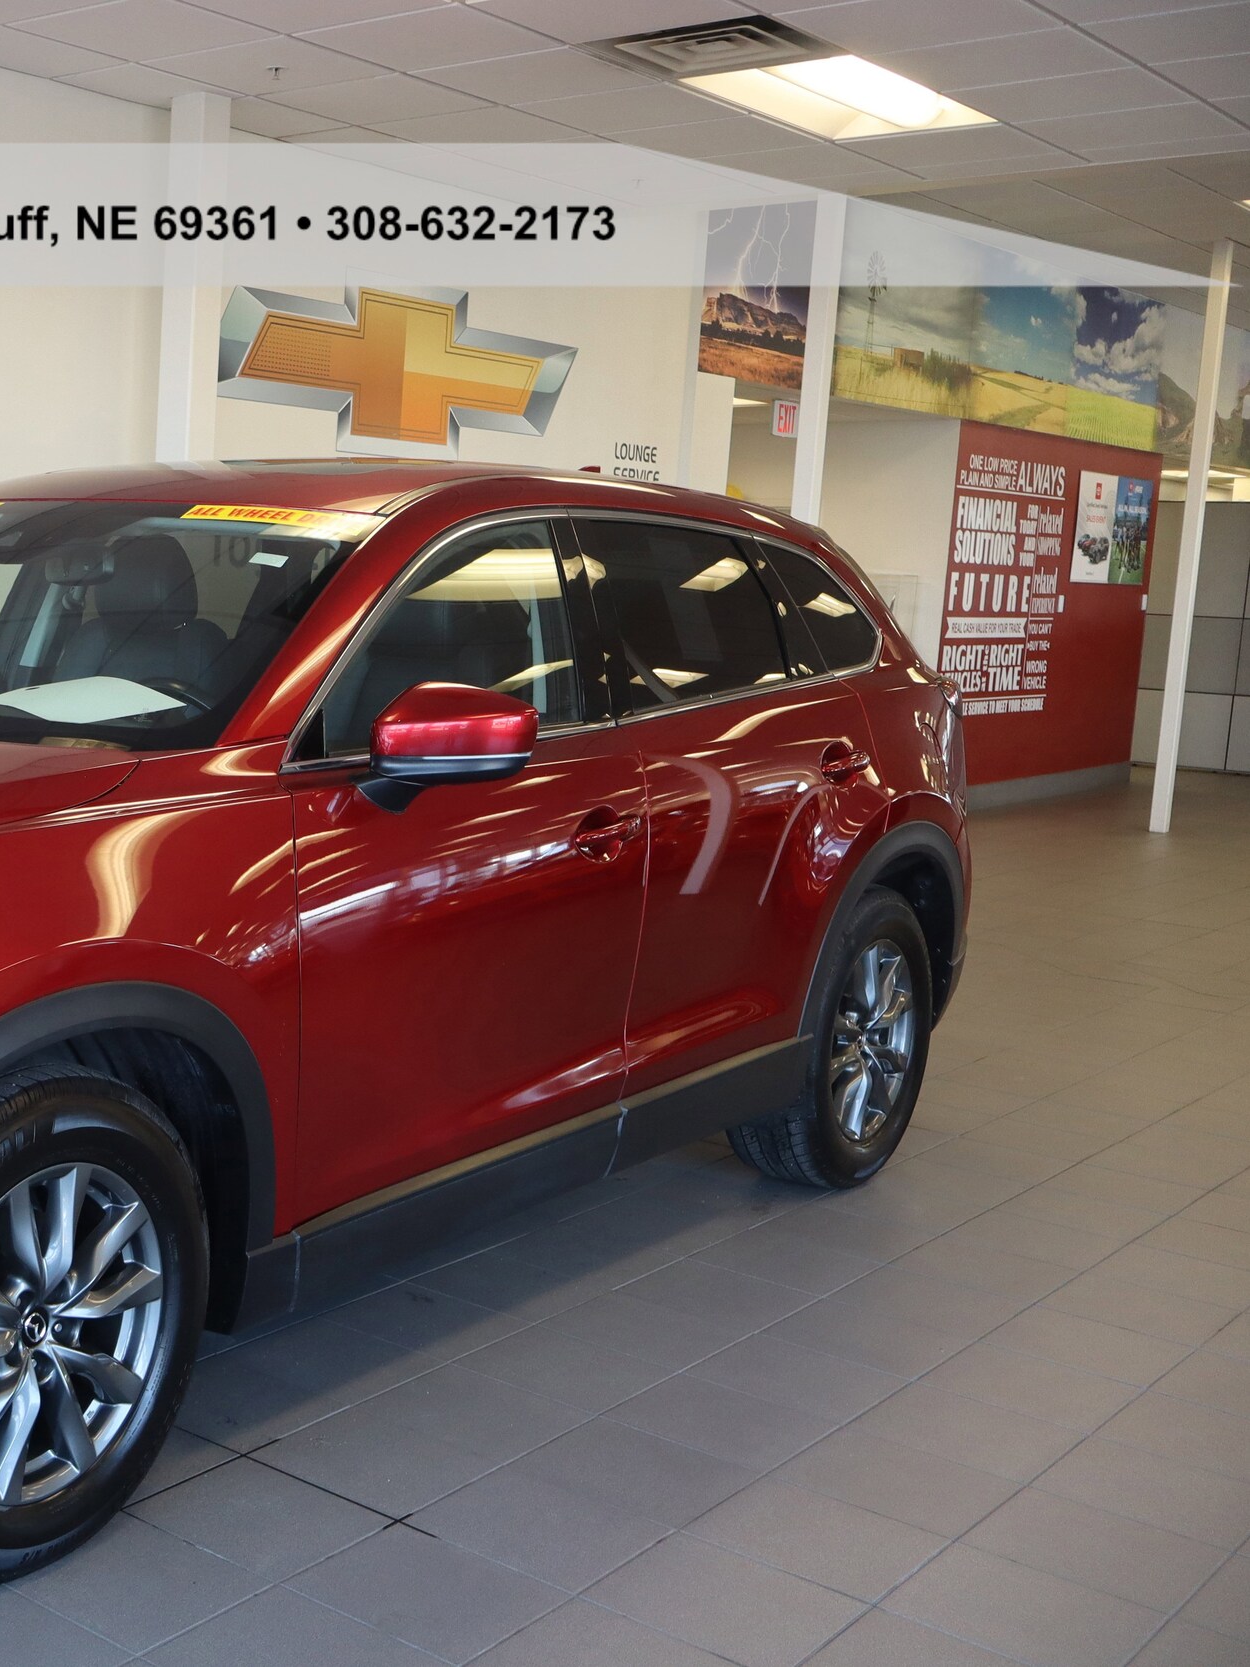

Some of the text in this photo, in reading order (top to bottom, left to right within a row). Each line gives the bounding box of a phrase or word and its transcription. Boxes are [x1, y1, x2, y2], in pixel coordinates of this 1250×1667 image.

[777, 403, 797, 434] EXIT
[614, 442, 658, 464] LOUNGE
[969, 455, 1018, 474] ONE LOW PRICE
[960, 471, 1017, 490] PLAIN AND SIMPLE
[1016, 462, 1066, 496] ALWAYS
[189, 506, 224, 518] ALL
[228, 507, 296, 521] WHEEL
[956, 496, 1018, 532] FINANCIAL
[1027, 505, 1039, 518] FOR
[1039, 507, 1064, 533] relaxed
[954, 531, 1016, 566] SOLUTIONS
[1033, 567, 1058, 593] relaxed
[948, 572, 1031, 612] FUTURE
[951, 623, 963, 634] REAL
[963, 623, 975, 634] CASH
[975, 623, 988, 634] VALUE
[989, 623, 997, 634] FOR
[998, 623, 1009, 634] YOUR
[1028, 623, 1053, 635] YOU CAN'T
[989, 645, 1025, 666] RIGHT
[1029, 640, 1048, 651] BUY THE
[941, 645, 985, 671] RIGHT
[1025, 661, 1048, 673] WRONG
[940, 672, 982, 692] ICLES
[987, 667, 1022, 691] TIME
[1024, 677, 1047, 689] VEHICLE
[968, 702, 989, 714] SERVICE
[996, 700, 1008, 713] MEET
